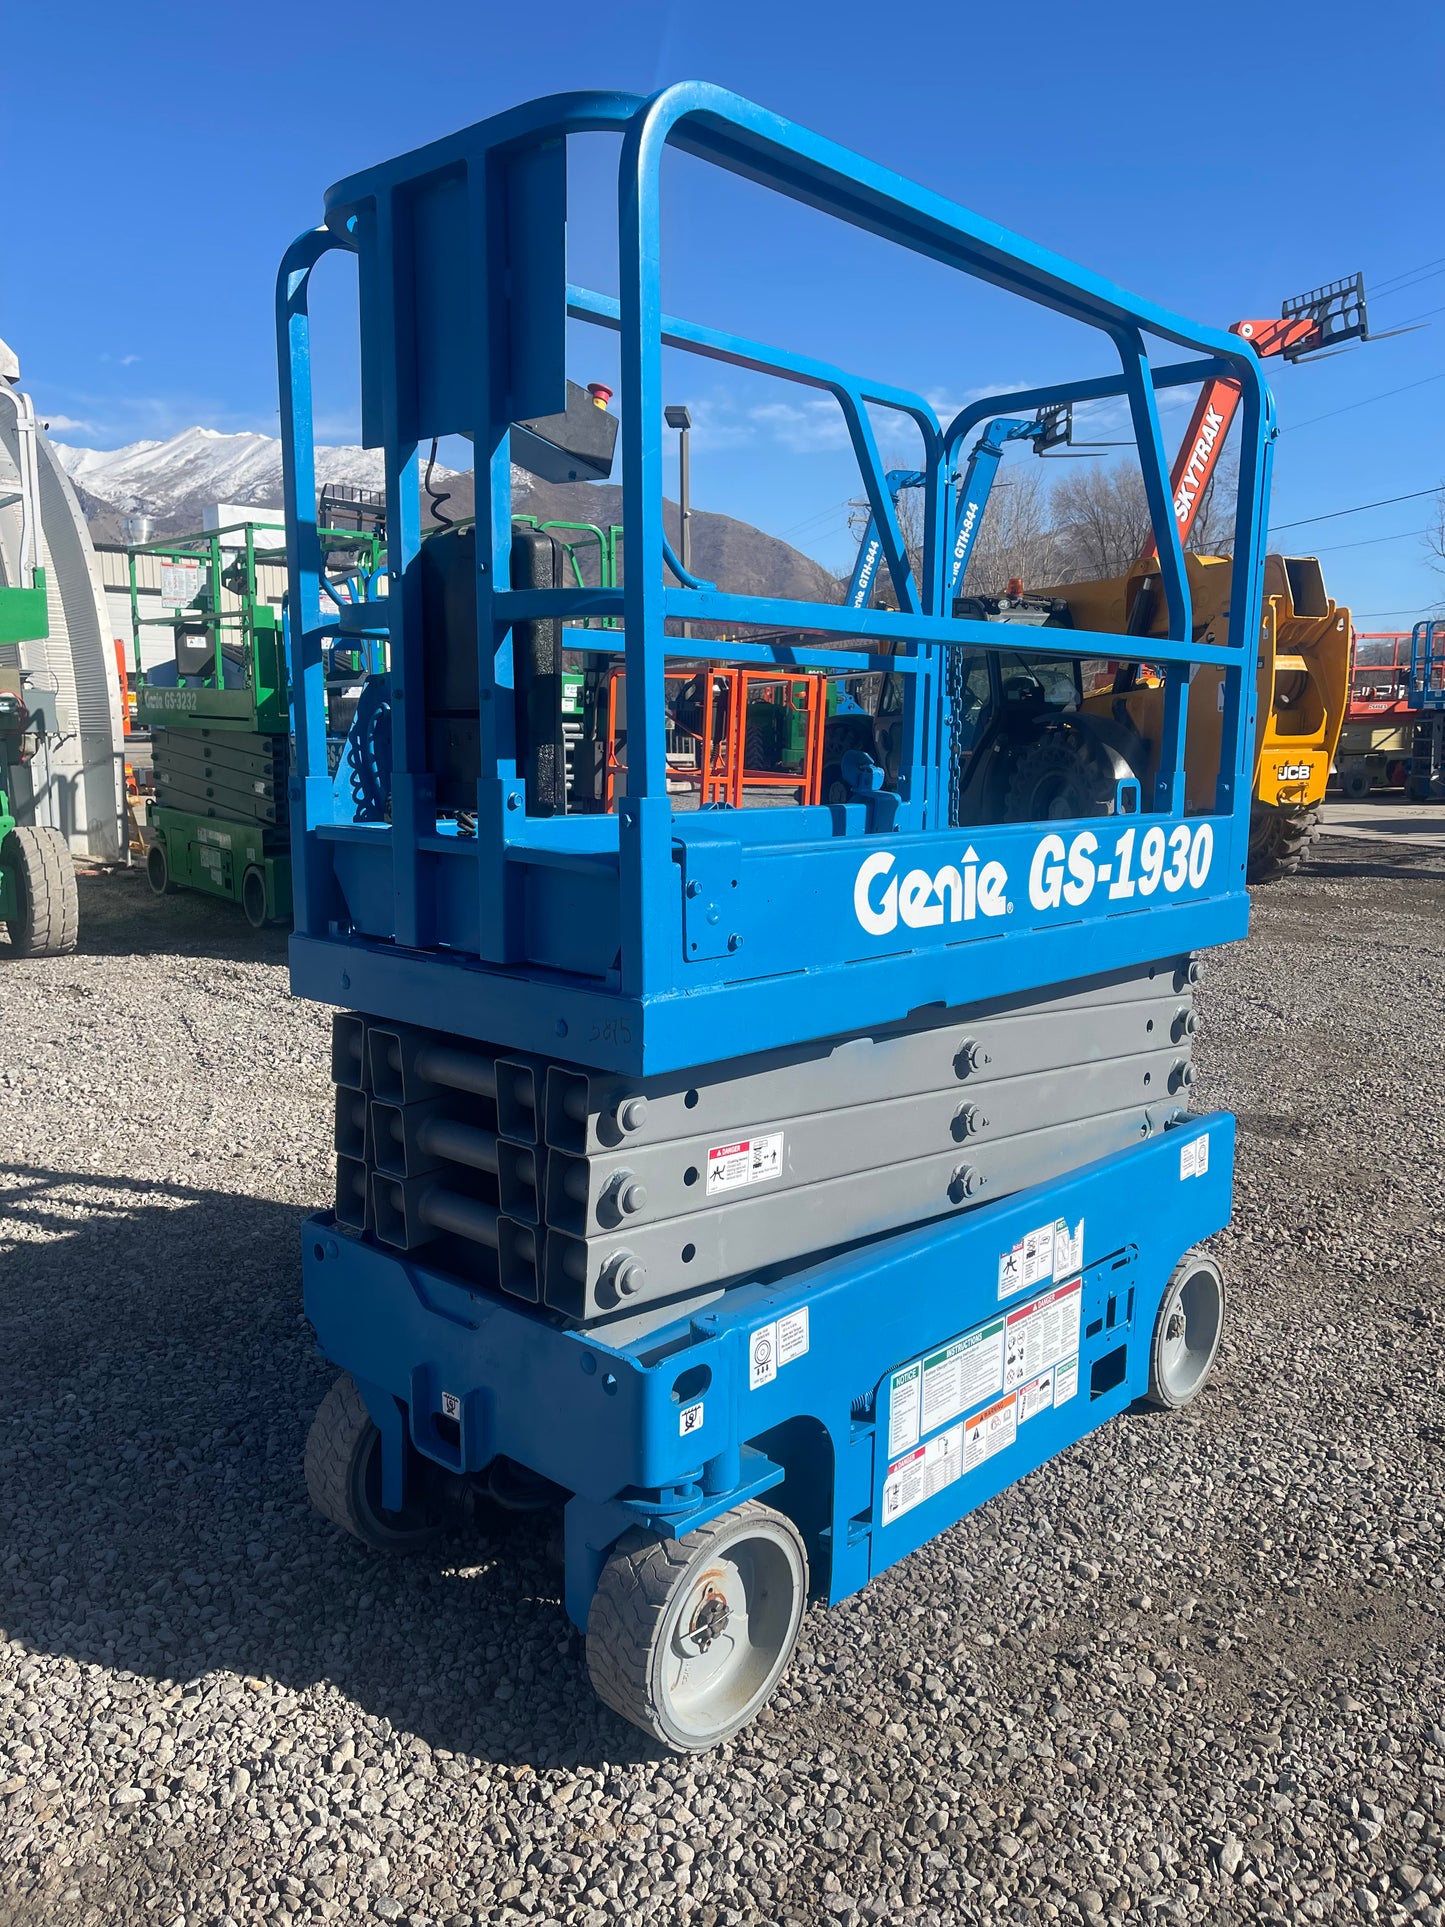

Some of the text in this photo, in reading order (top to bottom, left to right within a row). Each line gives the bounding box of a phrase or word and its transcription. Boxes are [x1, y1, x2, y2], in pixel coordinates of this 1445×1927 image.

[1173, 403, 1224, 522] SKYTRAK
[954, 502, 979, 559] GTH-844
[858, 540, 880, 588] GTH-844
[164, 691, 197, 710] GS-3232
[1278, 766, 1310, 780] JCB
[1028, 823, 1214, 911] GS-1930
[722, 1145, 741, 1156] DANGER
[1038, 1293, 1056, 1309] DANGER
[946, 1332, 983, 1358] INSTRUCTIONS
[896, 1369, 917, 1387] NOTICE
